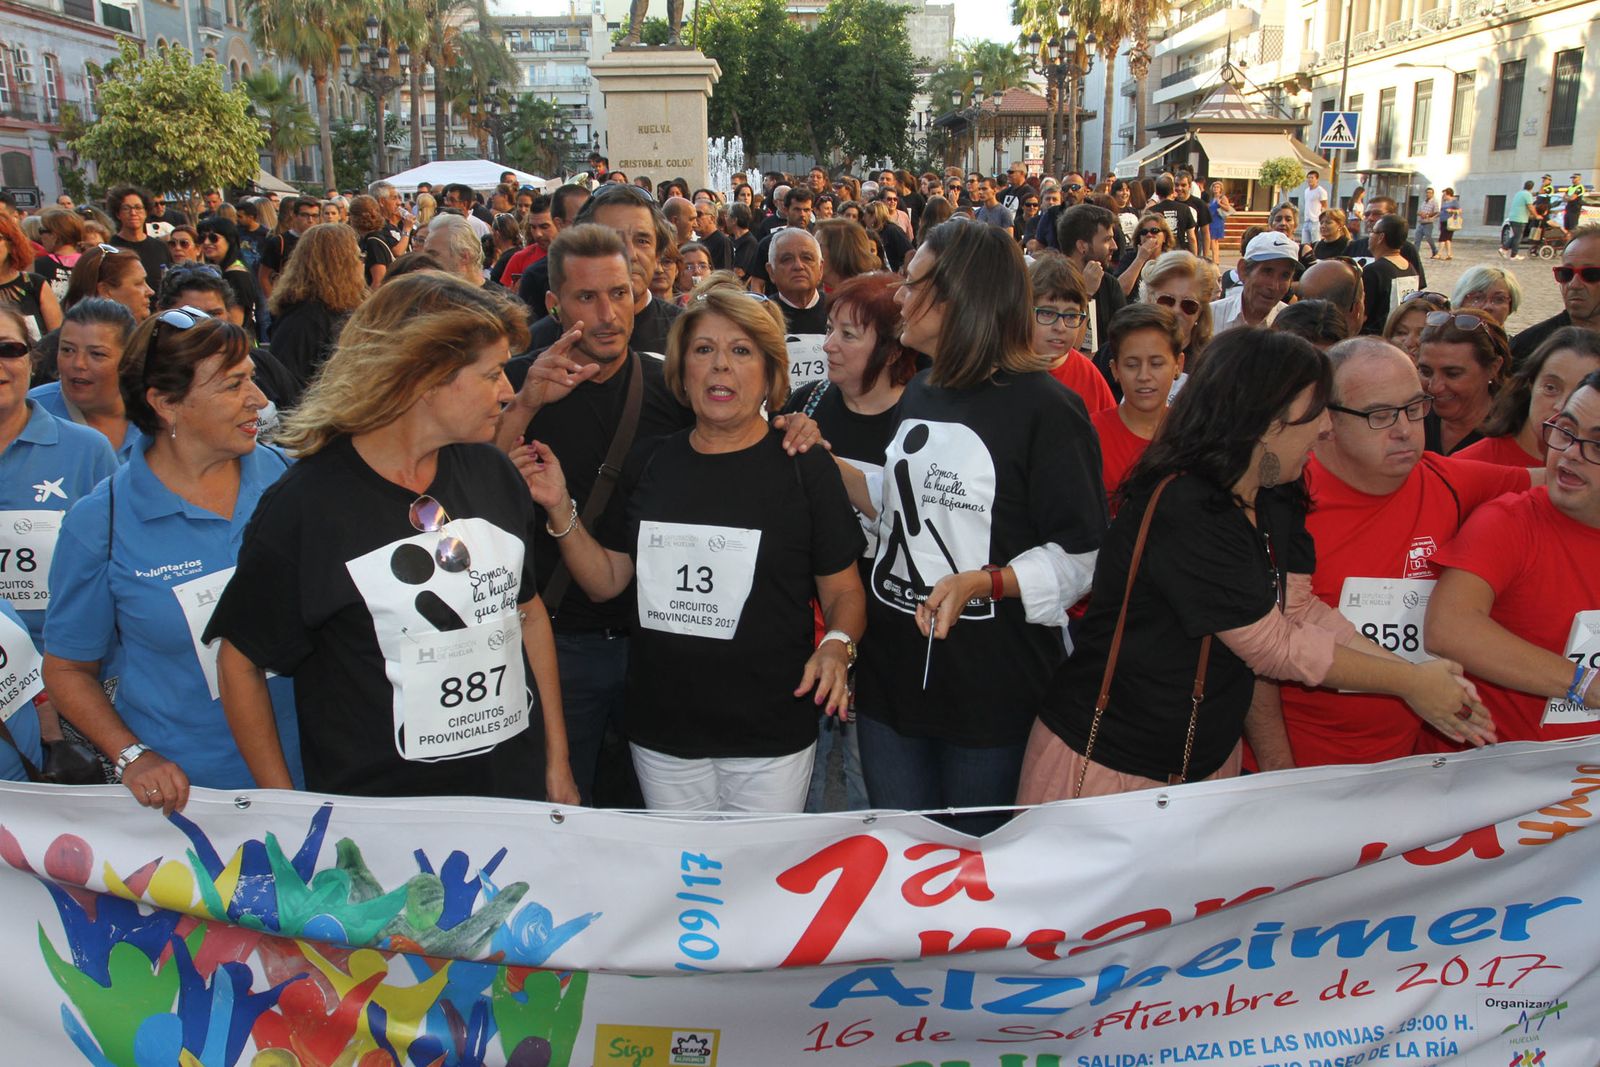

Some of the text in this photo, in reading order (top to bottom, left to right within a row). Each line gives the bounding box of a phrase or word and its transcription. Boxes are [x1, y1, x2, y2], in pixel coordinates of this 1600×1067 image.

[638, 125, 671, 134] HUELVA
[619, 159, 663, 168] CRISTOBAL
[791, 360, 825, 376] 473
[927, 463, 959, 480] Somos
[923, 475, 967, 496] la huella
[921, 492, 986, 512] que dejamos
[468, 565, 508, 588] Somos
[675, 564, 714, 594] 13
[472, 585, 487, 603] la
[474, 604, 499, 624] que
[669, 600, 719, 614] CIRCUITOS
[647, 610, 736, 628] PROVINCIALES 2017
[18, 668, 41, 690] 2017
[440, 664, 507, 708] 887
[447, 705, 505, 728] CIRCUITOS
[418, 710, 522, 746] PROVINCIALES 2017
[804, 953, 1564, 1052] 16 de Septiembre de 2017
[1077, 1052, 1153, 1067] SALIDA:
[1159, 1041, 1224, 1065] PLAZA
[1229, 1038, 1255, 1057] DE
[1260, 1034, 1299, 1054] LAS
[1303, 1025, 1385, 1050] MONJAS
[1396, 1014, 1448, 1034] 19:00
[1454, 1013, 1475, 1031] H.
[1367, 1043, 1390, 1062] DE
[1395, 1041, 1420, 1058] LA
[1425, 1036, 1459, 1058] RÍA
[608, 1036, 655, 1067] Sigo
